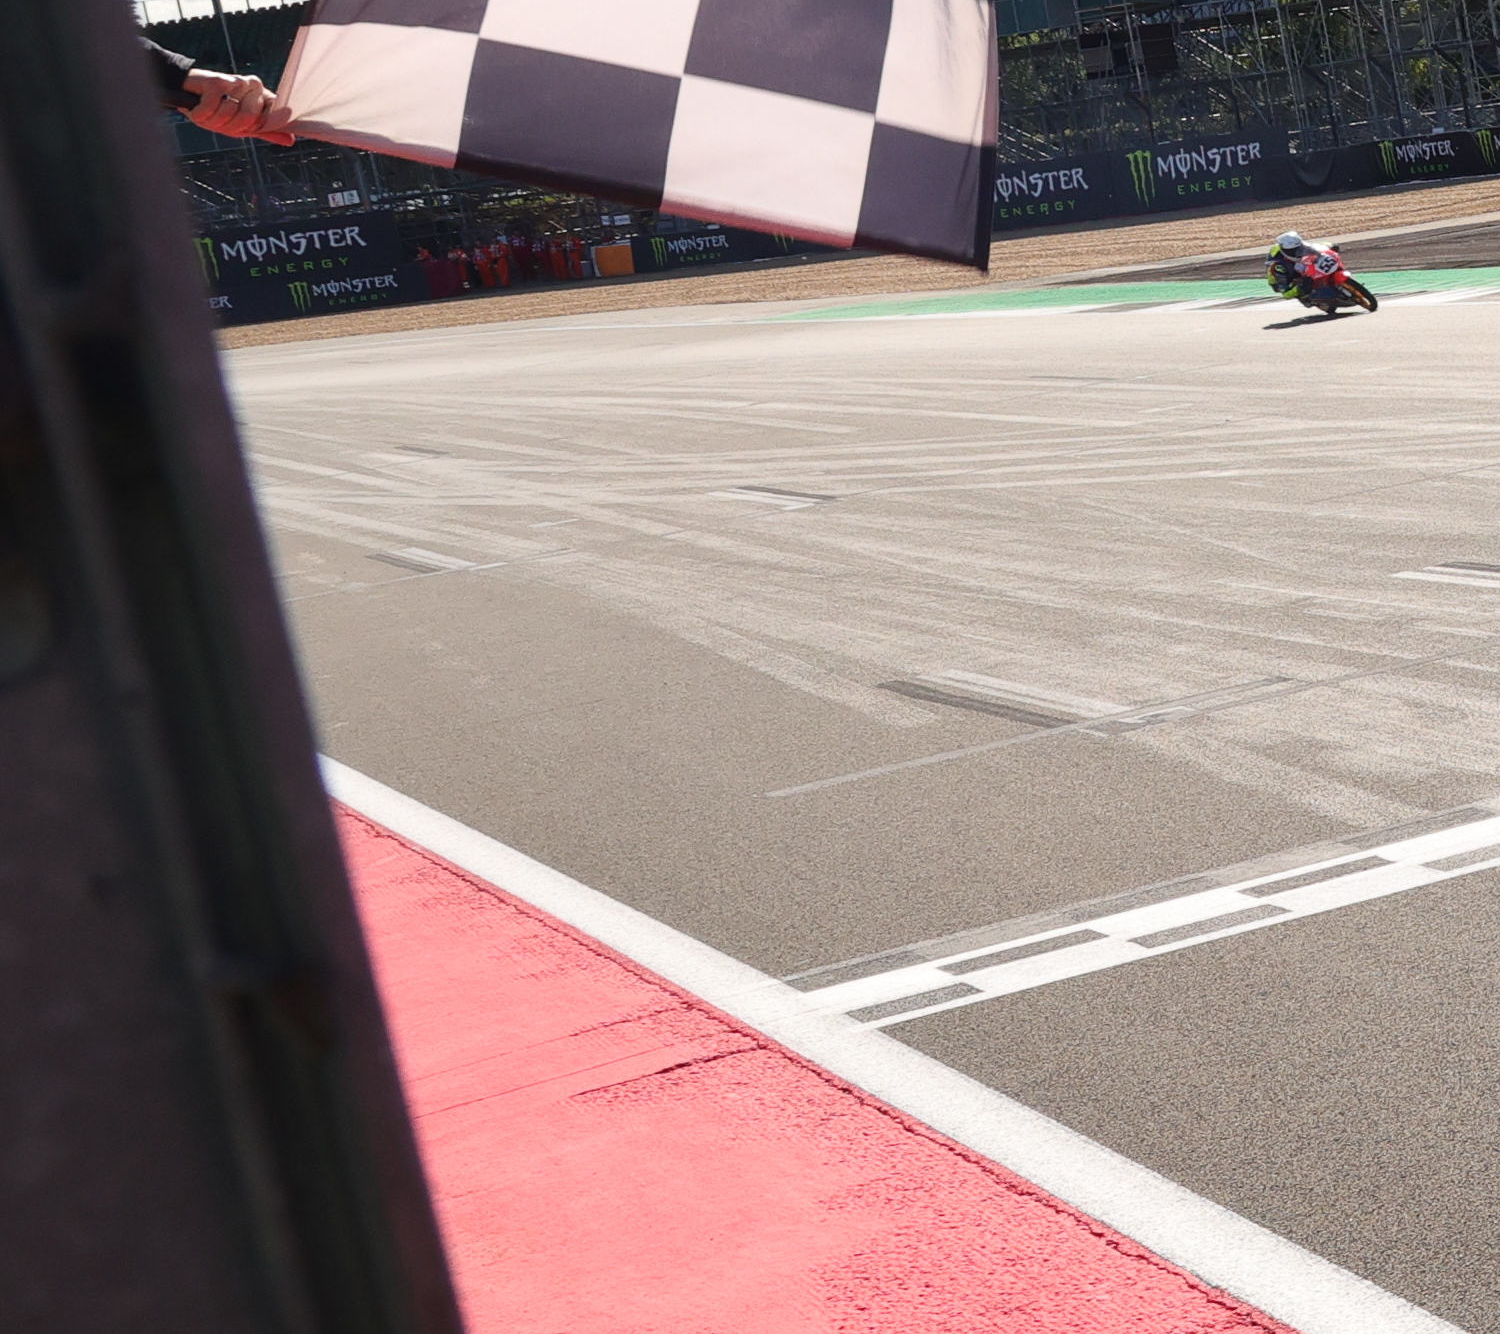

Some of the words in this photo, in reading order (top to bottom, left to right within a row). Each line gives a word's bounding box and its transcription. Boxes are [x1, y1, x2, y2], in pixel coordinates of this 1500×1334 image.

[1157, 142, 1261, 179] MONSTER
[1395, 139, 1455, 163] MONSTER
[1177, 175, 1253, 196] ENERGY
[999, 200, 1076, 218] ENERGY
[221, 225, 368, 263] MONSTER
[667, 234, 729, 255] MONSTER
[250, 257, 350, 277] ENERGY
[312, 274, 398, 297] MONSTER
